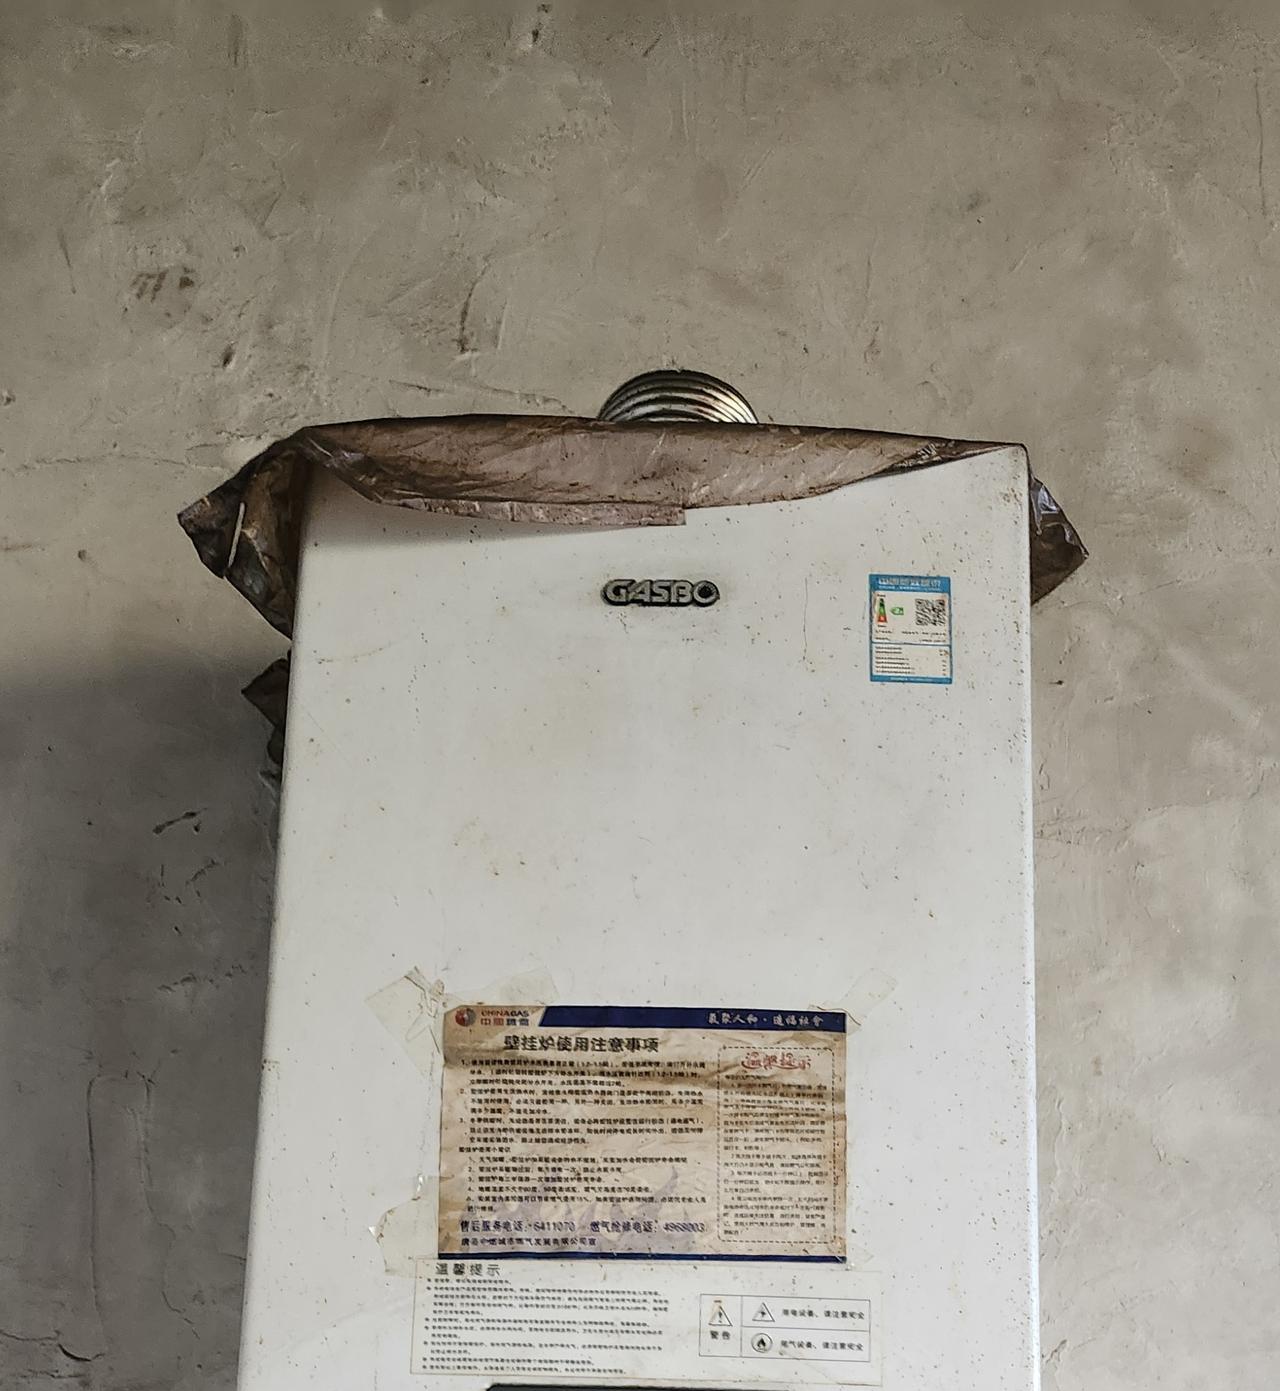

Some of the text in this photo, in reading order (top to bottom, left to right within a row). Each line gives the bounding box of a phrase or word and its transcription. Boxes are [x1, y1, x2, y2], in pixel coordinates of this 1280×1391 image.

[602, 579, 720, 606] GASBO
[503, 1034, 659, 1053] 壁挂炉使用注意事项
[434, 1263, 501, 1276] 温馨提示
